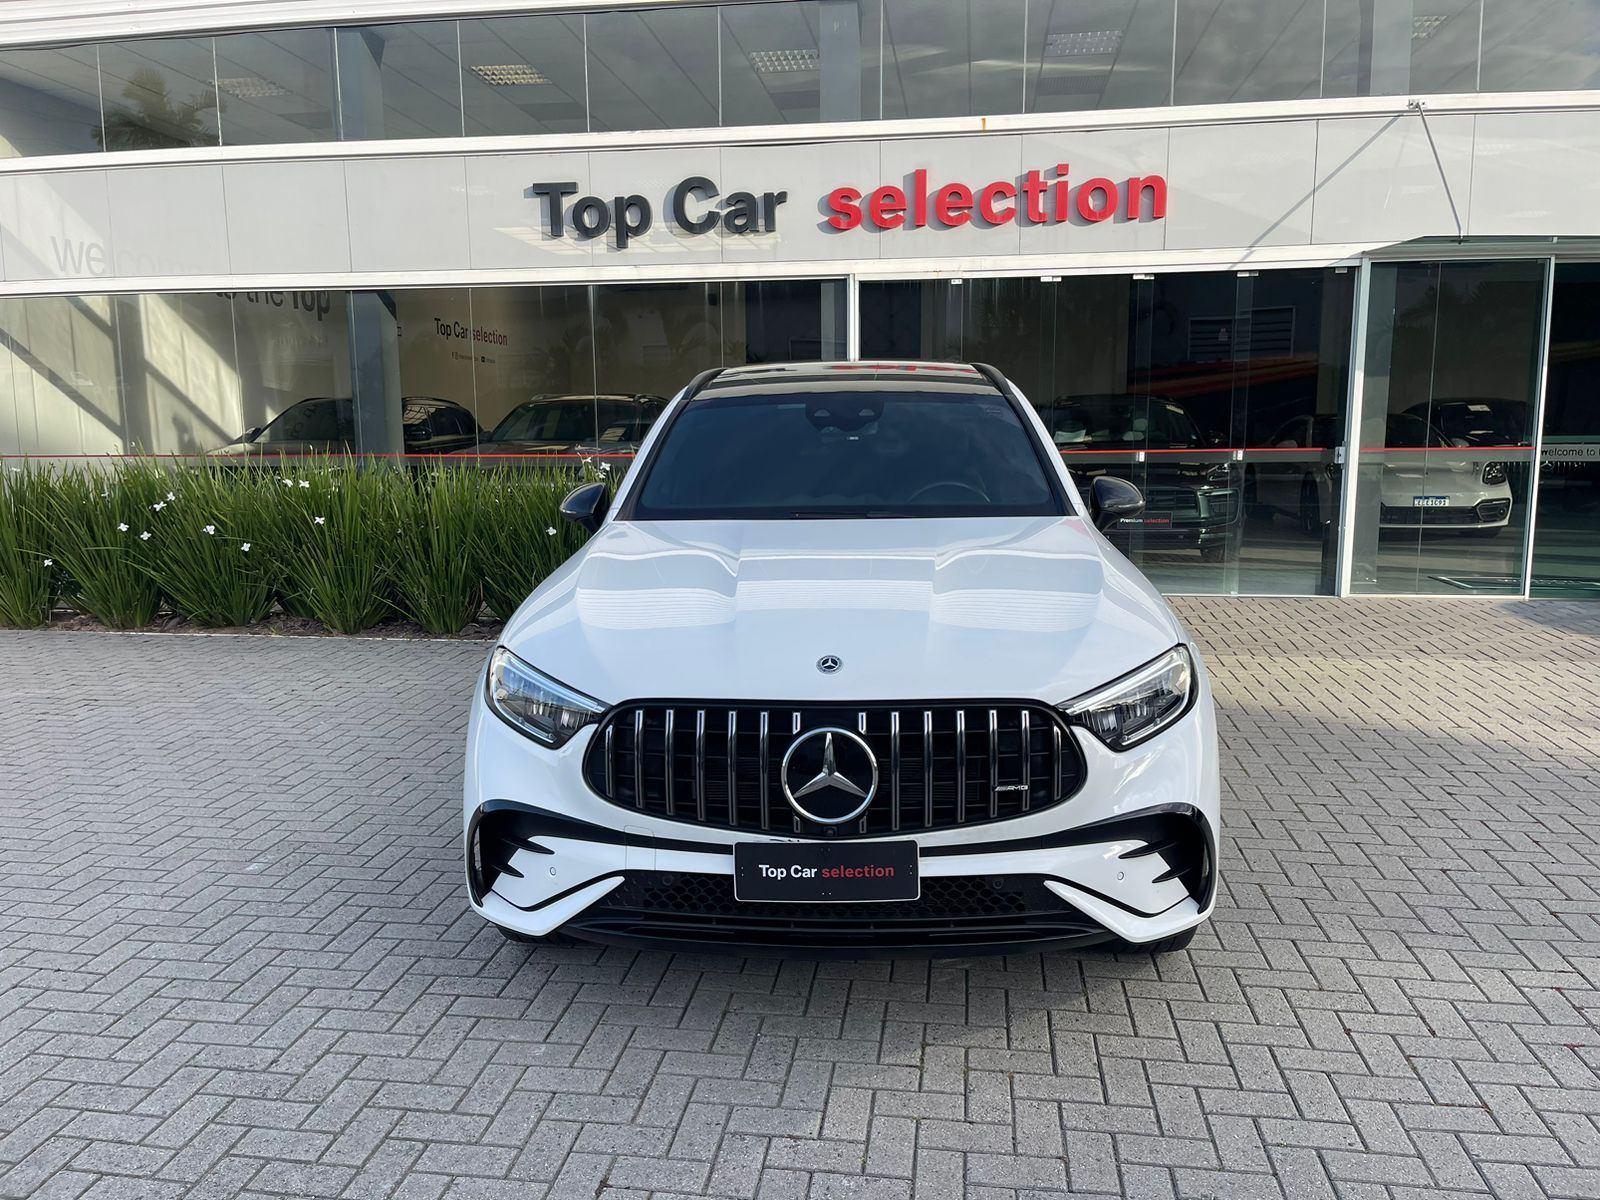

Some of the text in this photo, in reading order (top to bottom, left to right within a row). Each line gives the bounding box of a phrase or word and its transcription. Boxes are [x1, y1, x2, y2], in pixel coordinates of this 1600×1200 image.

[531, 163, 1168, 249] Top Car selection
[434, 317, 508, 346] Top Car selection
[1541, 448, 1583, 457] welcome
[1586, 448, 1596, 456] to
[758, 864, 895, 881] Top Car selection
